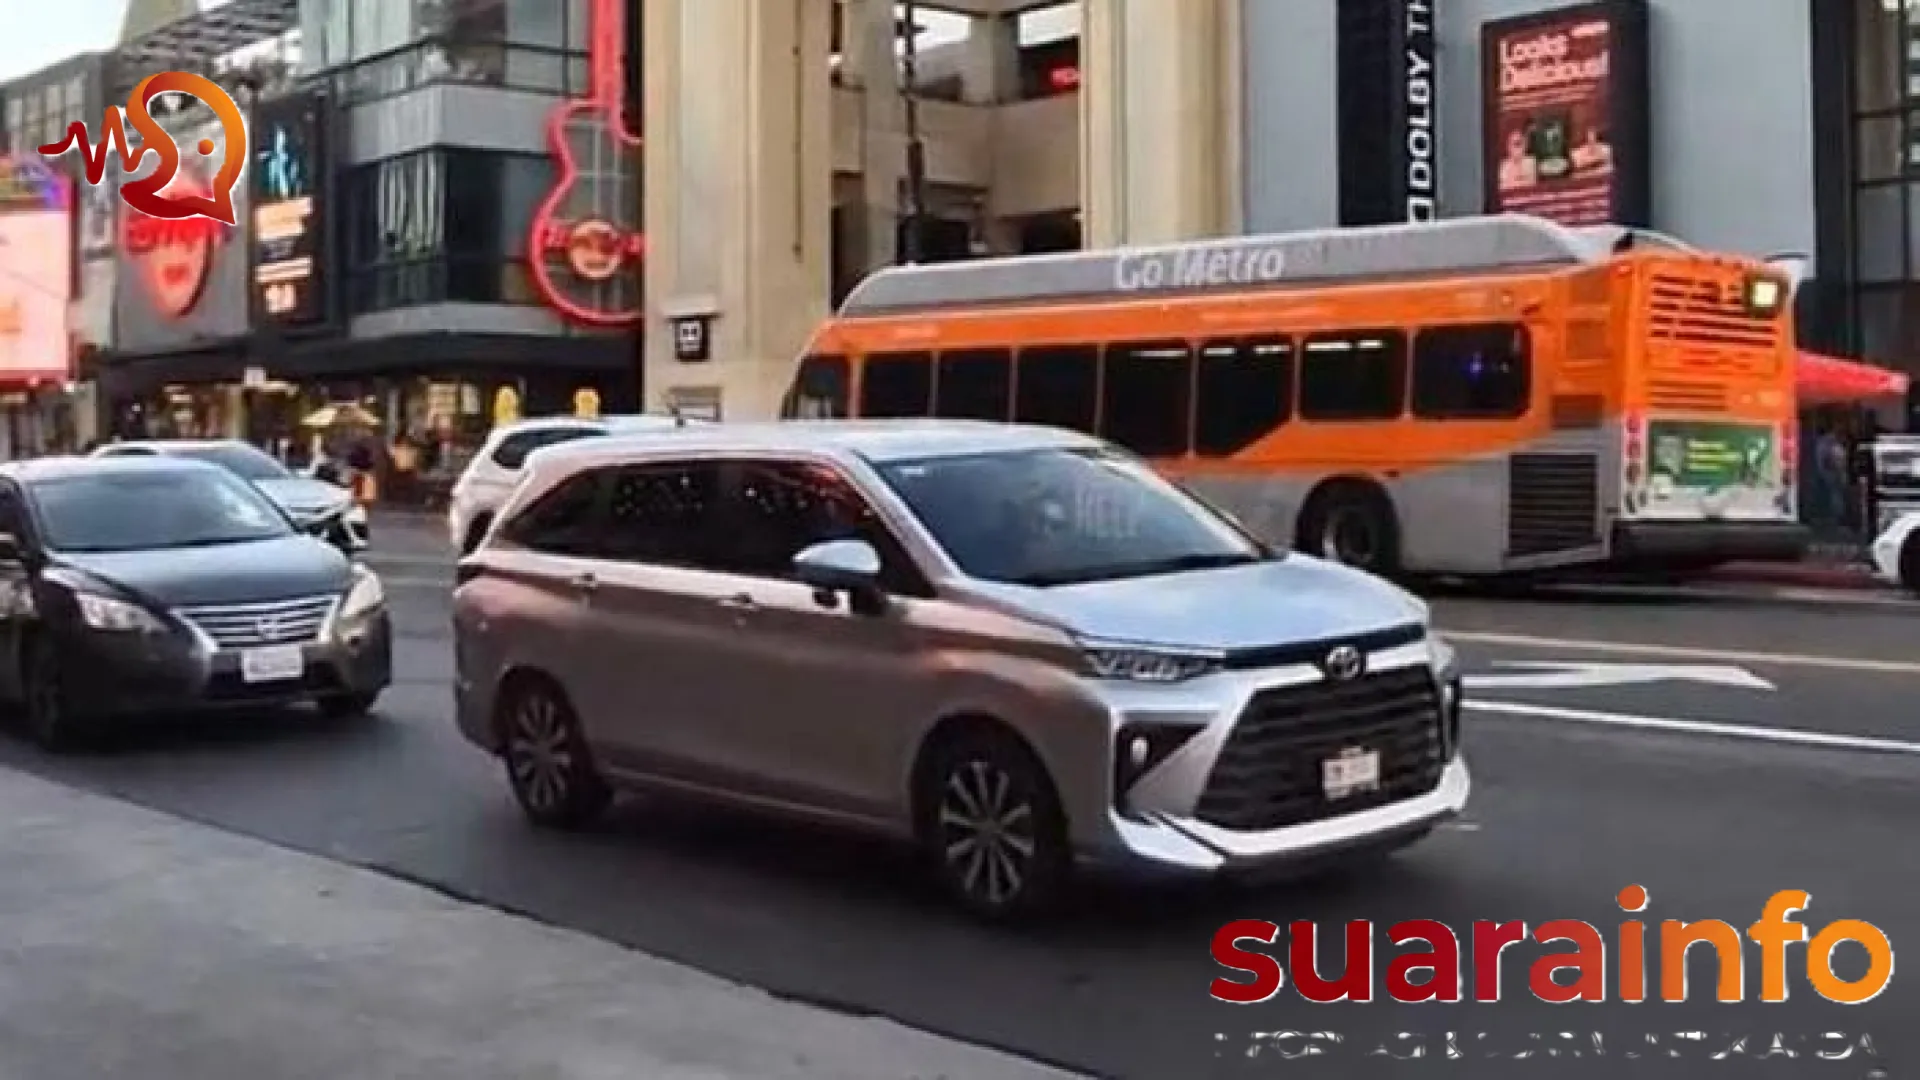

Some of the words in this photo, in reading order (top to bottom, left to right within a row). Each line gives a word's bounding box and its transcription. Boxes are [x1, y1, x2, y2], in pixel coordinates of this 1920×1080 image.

[1407, 50, 1430, 190] DOLBY
[1116, 249, 1163, 290] Go
[1175, 245, 1284, 286] Metro
